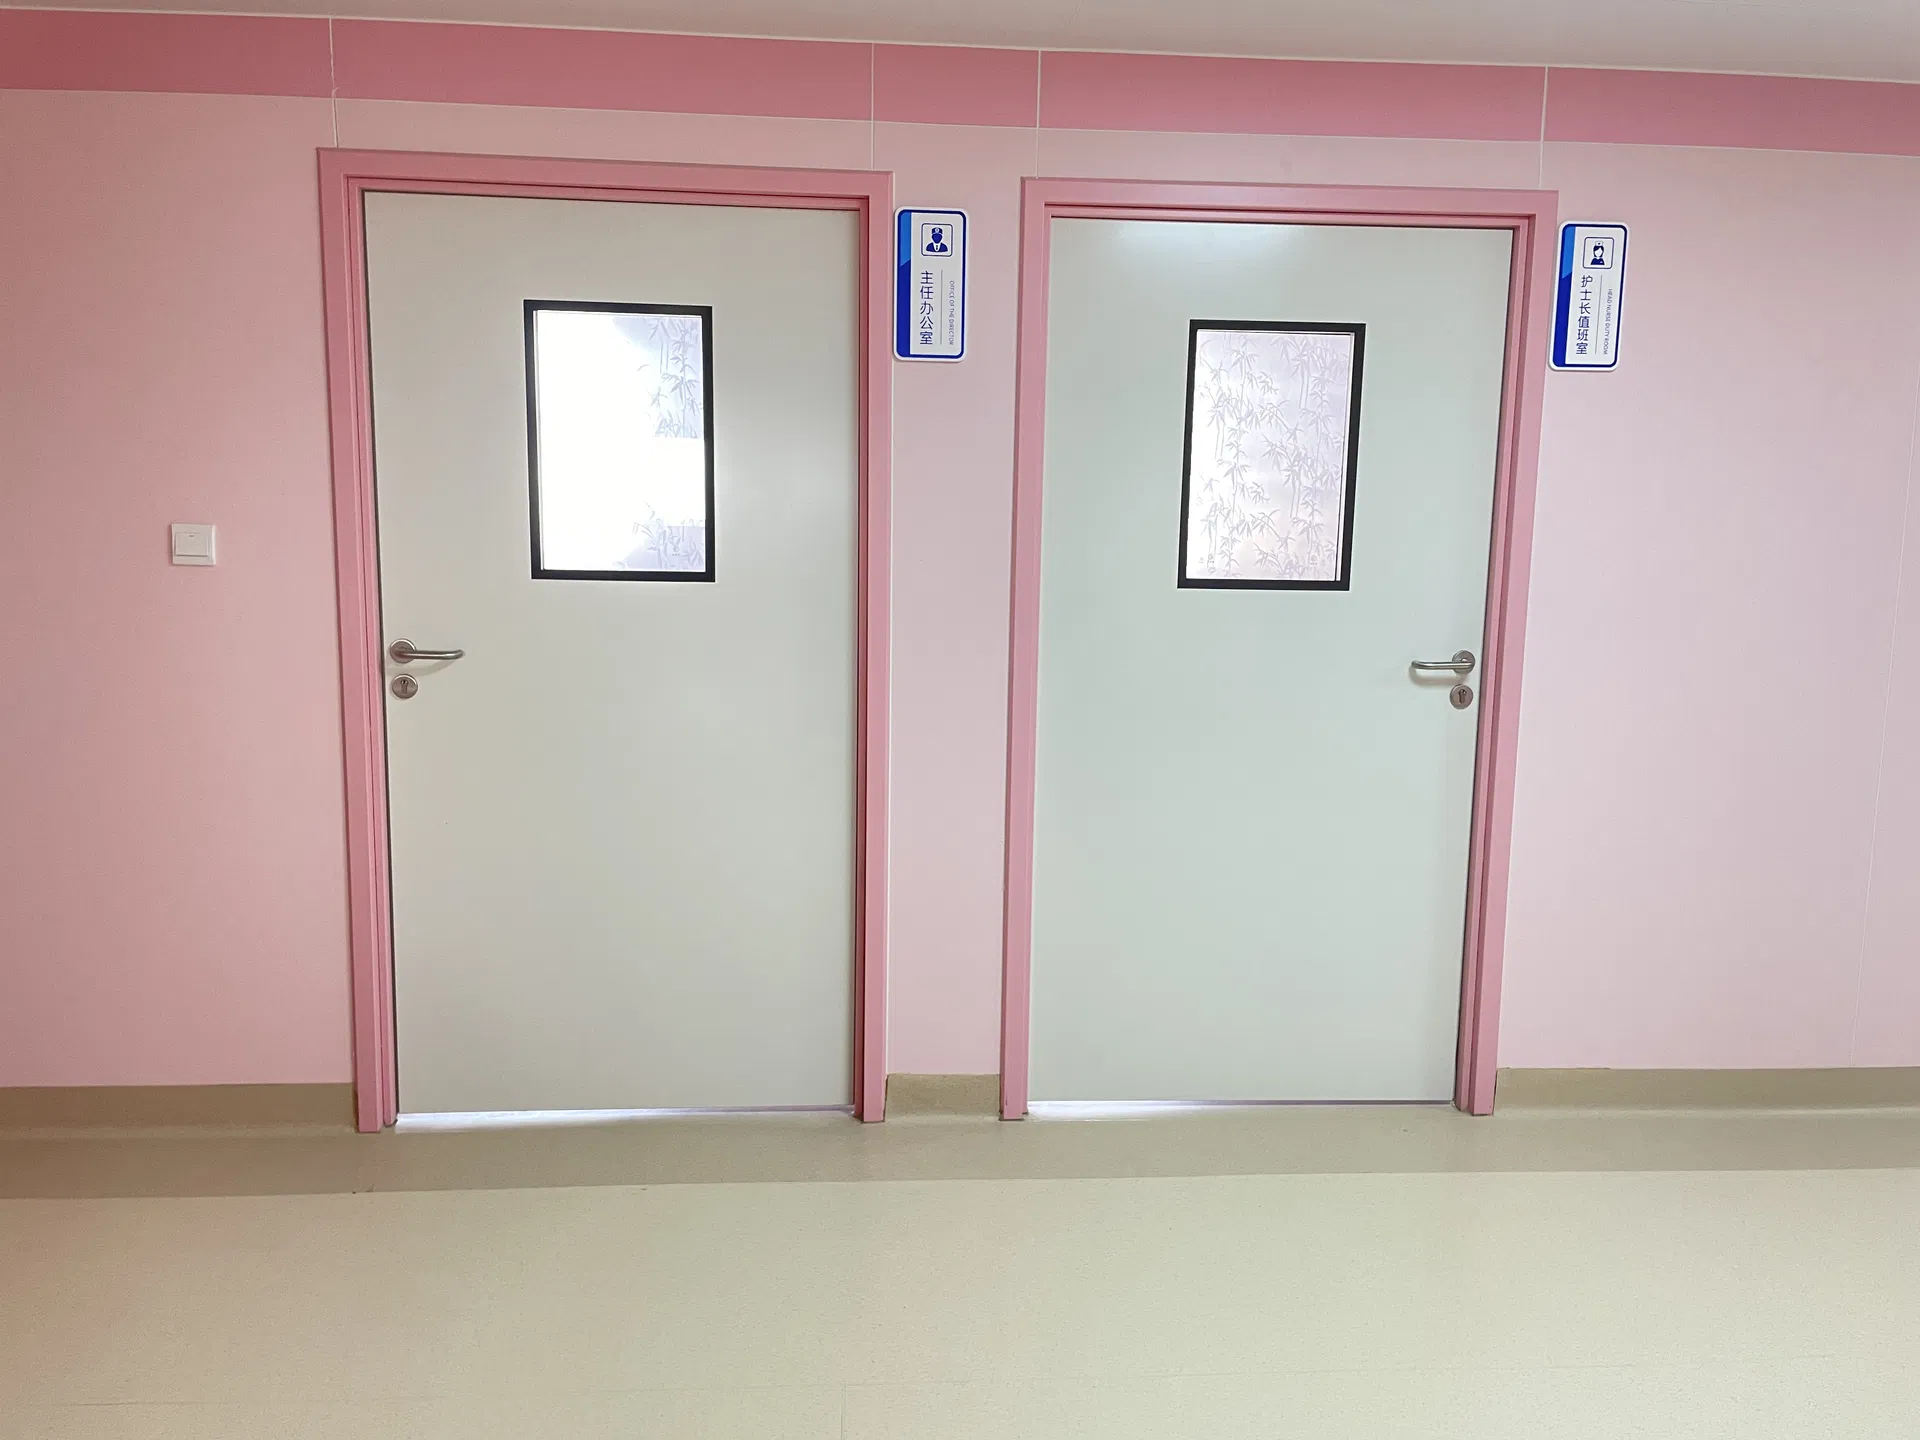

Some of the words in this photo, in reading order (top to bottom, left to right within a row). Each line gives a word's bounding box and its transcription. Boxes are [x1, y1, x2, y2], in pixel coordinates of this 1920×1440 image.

[920, 271, 934, 345] 主任办公室
[1576, 275, 1594, 355] 护士长值班室
